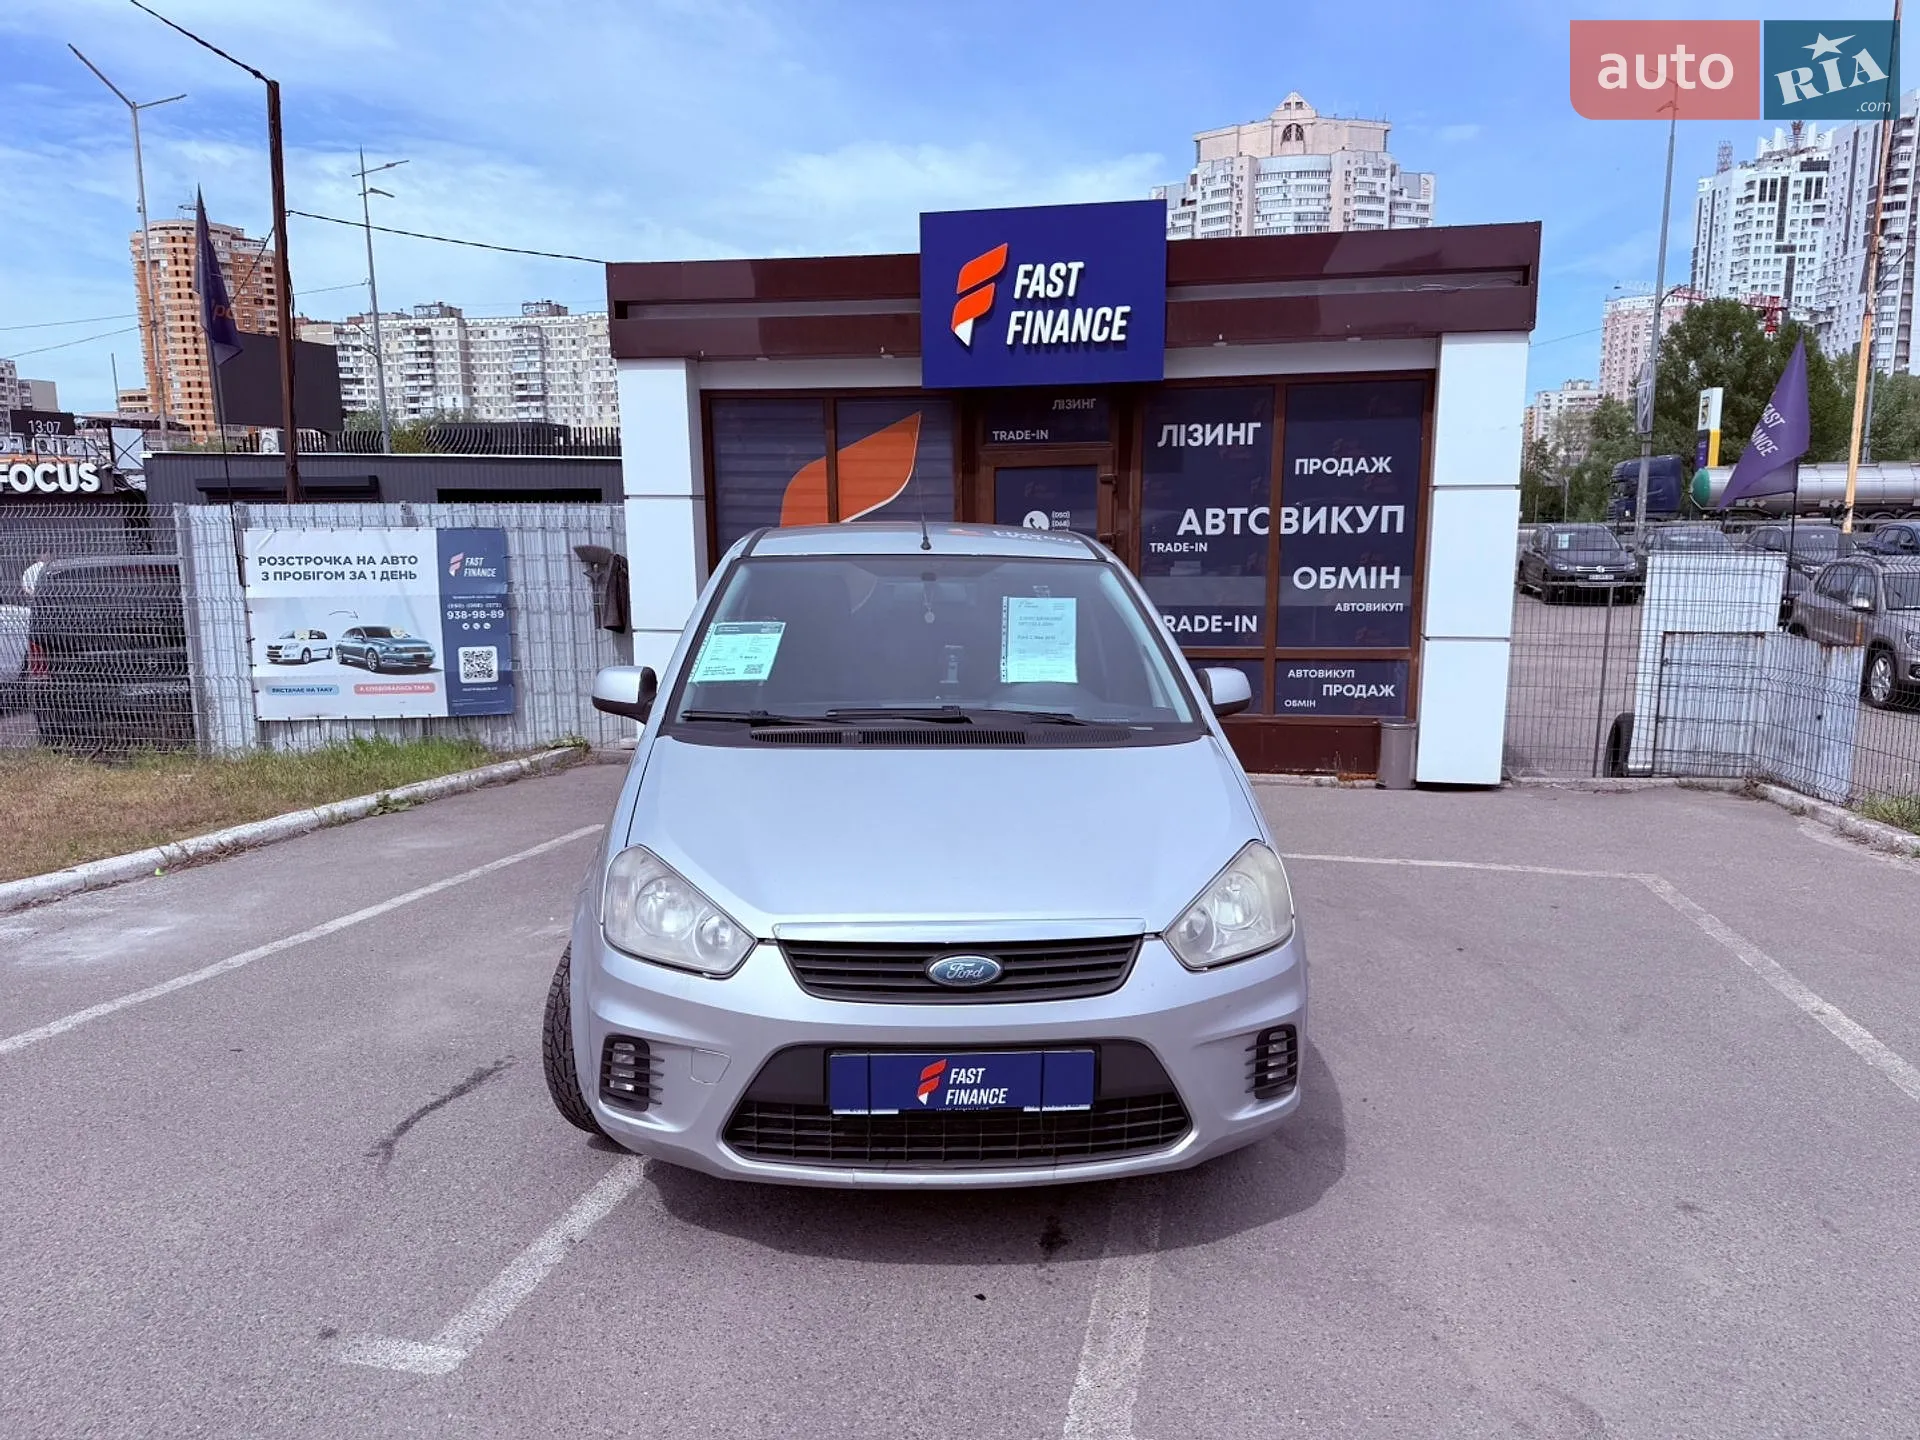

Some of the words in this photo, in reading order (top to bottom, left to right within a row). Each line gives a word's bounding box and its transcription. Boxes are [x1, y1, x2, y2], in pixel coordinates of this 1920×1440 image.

[1014, 261, 1085, 300] FAST
[1006, 305, 1132, 346] FINANCE
[1052, 398, 1097, 411] ЛІЗИНГ
[28, 419, 61, 434] 13:07
[992, 429, 1049, 441] TRADE-IN
[1157, 422, 1261, 448] ЛІЗИНГ
[1294, 456, 1392, 476] ПРОДАЖ
[0, 461, 101, 493] FOCUS
[1176, 504, 1405, 536] АВТОВИКУП
[1150, 542, 1208, 553] TRADE-IN
[258, 555, 353, 567] РОЗСТРОЧКА
[356, 555, 377, 566] НА
[380, 555, 418, 566] АВТО
[465, 557, 485, 567] FAST
[273, 570, 345, 582] ПРОБІГОМ
[349, 571, 367, 580] ЗА
[371, 571, 376, 580] 1
[380, 570, 417, 582] ДЕНЬ
[464, 567, 497, 577] FINANCE
[1293, 566, 1400, 590] ОБМІН
[446, 609, 504, 619] 938-98-89
[1335, 602, 1403, 612] АВТОВИКУП
[1162, 615, 1258, 632] RADE-IN
[1287, 669, 1355, 678] АВТОВИКУП
[1322, 684, 1396, 698] ПРОДАЖ
[1284, 699, 1316, 707] ОБМІН
[946, 962, 985, 979] Ford
[949, 1067, 986, 1084] FAST
[945, 1087, 1009, 1105] FINANCE
